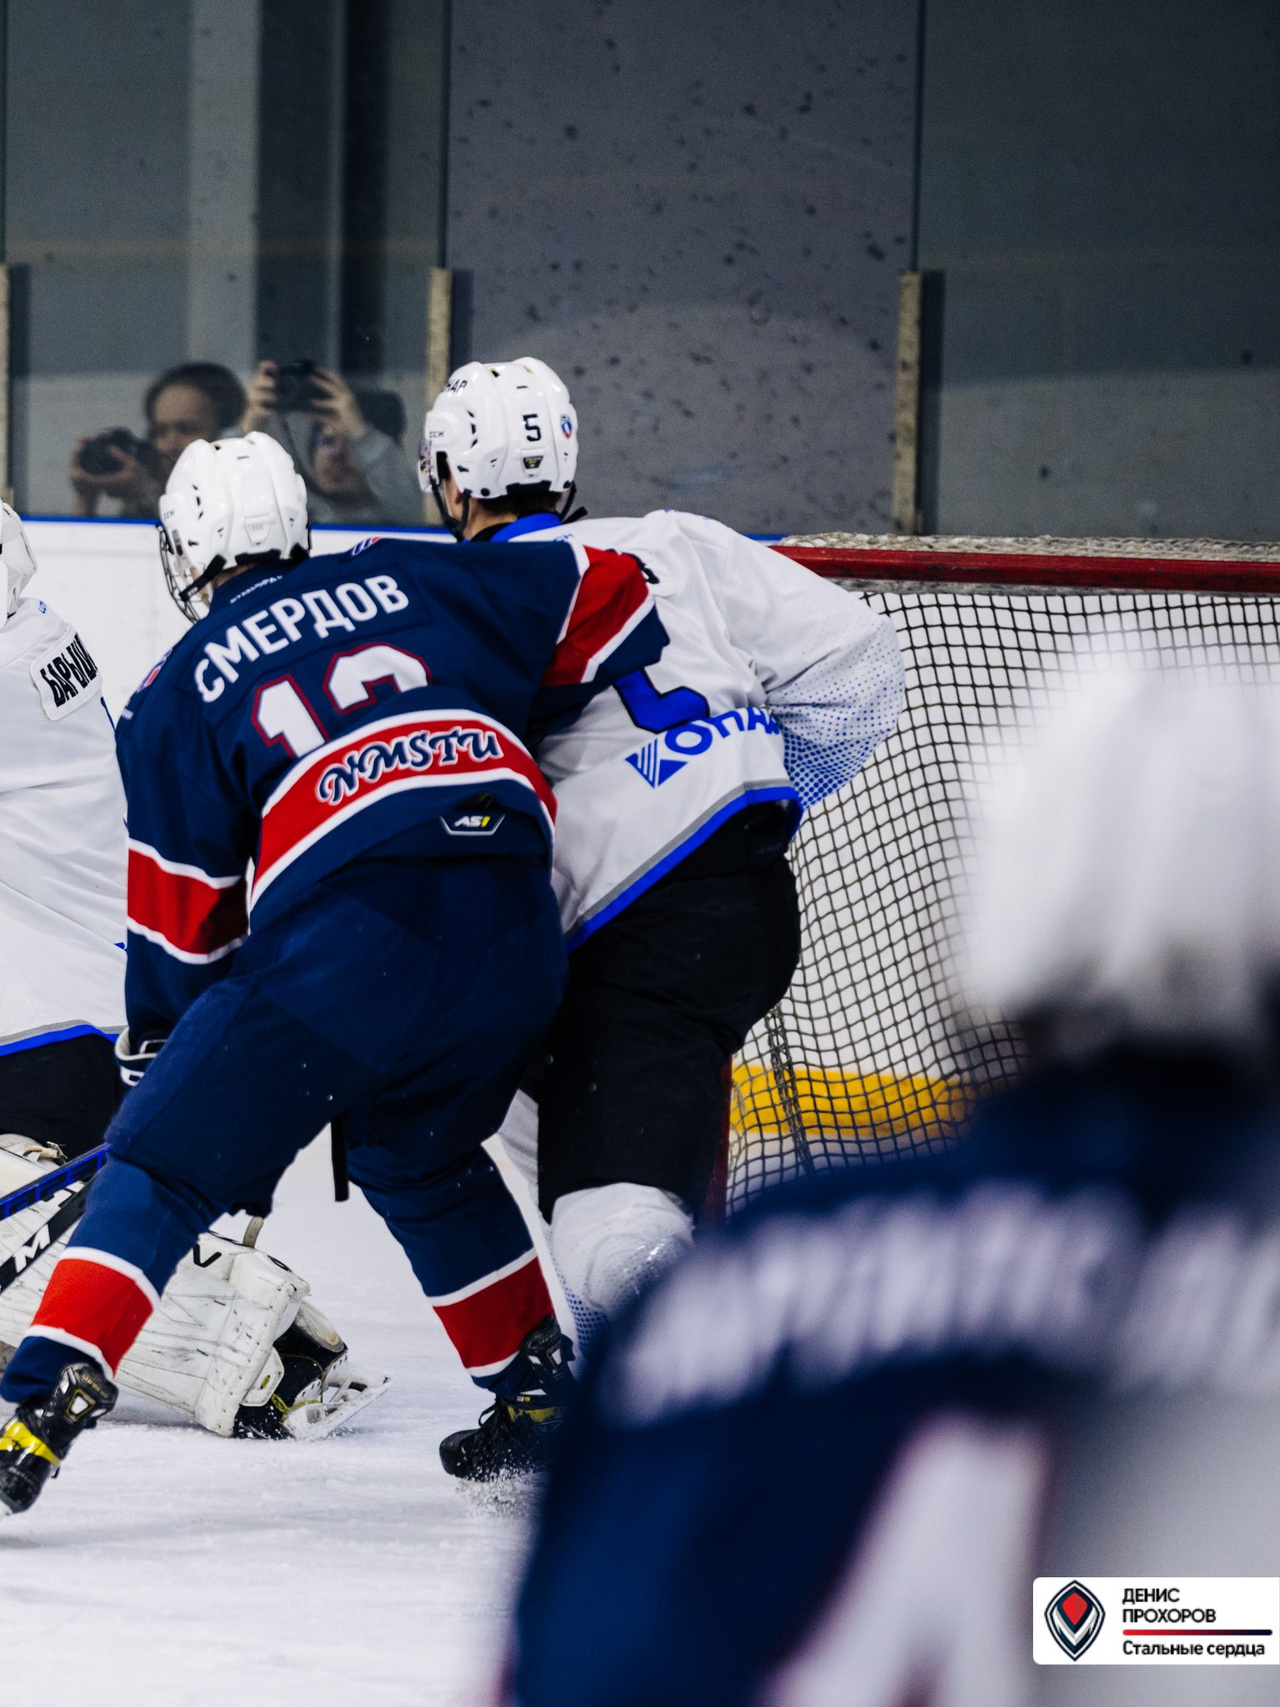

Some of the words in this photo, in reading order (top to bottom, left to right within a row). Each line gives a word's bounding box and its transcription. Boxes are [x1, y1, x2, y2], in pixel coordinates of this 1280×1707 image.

[429, 430, 444, 438] CCM
[522, 413, 541, 442] 5
[194, 574, 410, 703] СМЕРДОВ
[317, 728, 502, 804] NMSTU
